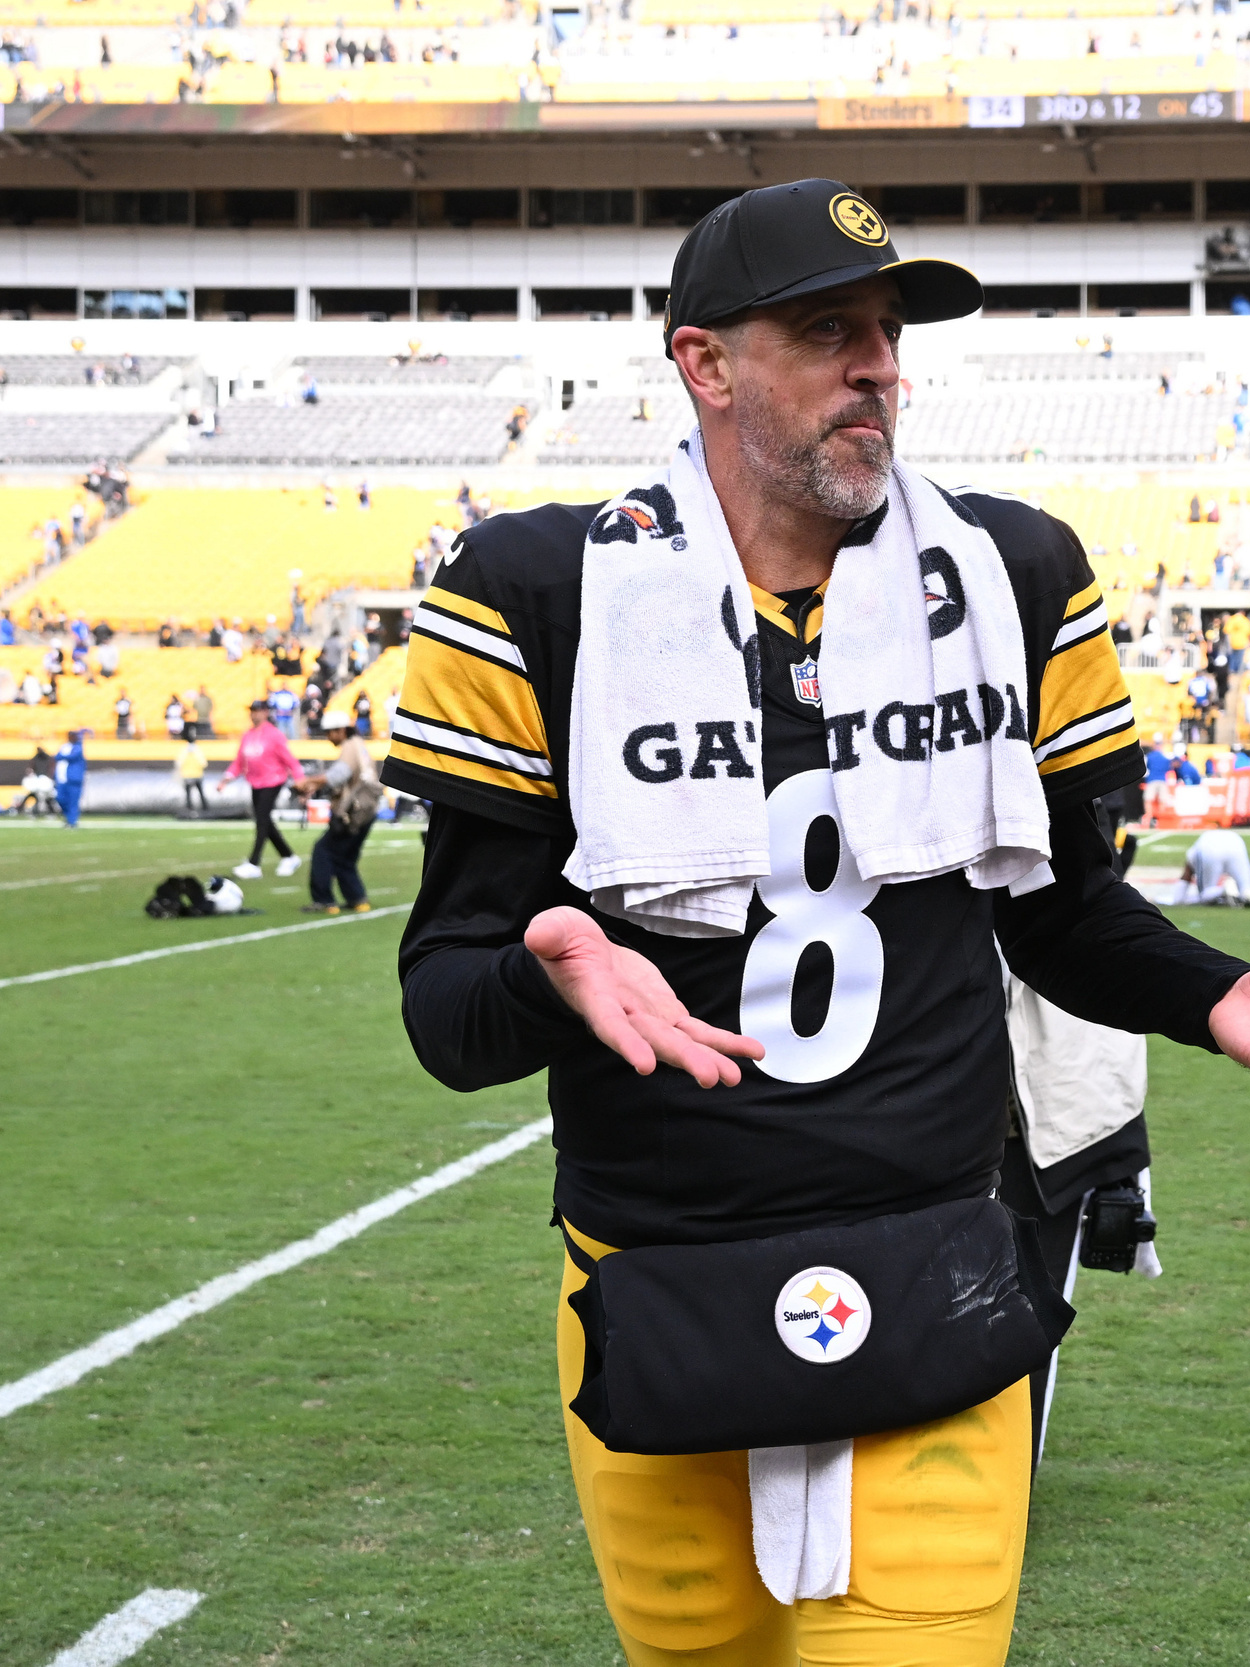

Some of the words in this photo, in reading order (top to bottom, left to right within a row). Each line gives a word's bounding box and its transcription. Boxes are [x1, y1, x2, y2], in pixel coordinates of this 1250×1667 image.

[846, 99, 932, 121] Steelers
[1037, 95, 1088, 121] 3RD
[1112, 94, 1142, 120] 12
[1190, 91, 1224, 118] 45
[800, 678, 820, 699] NF
[622, 720, 757, 784] GA
[739, 768, 885, 1084] 8
[783, 1309, 820, 1322] Steelers
